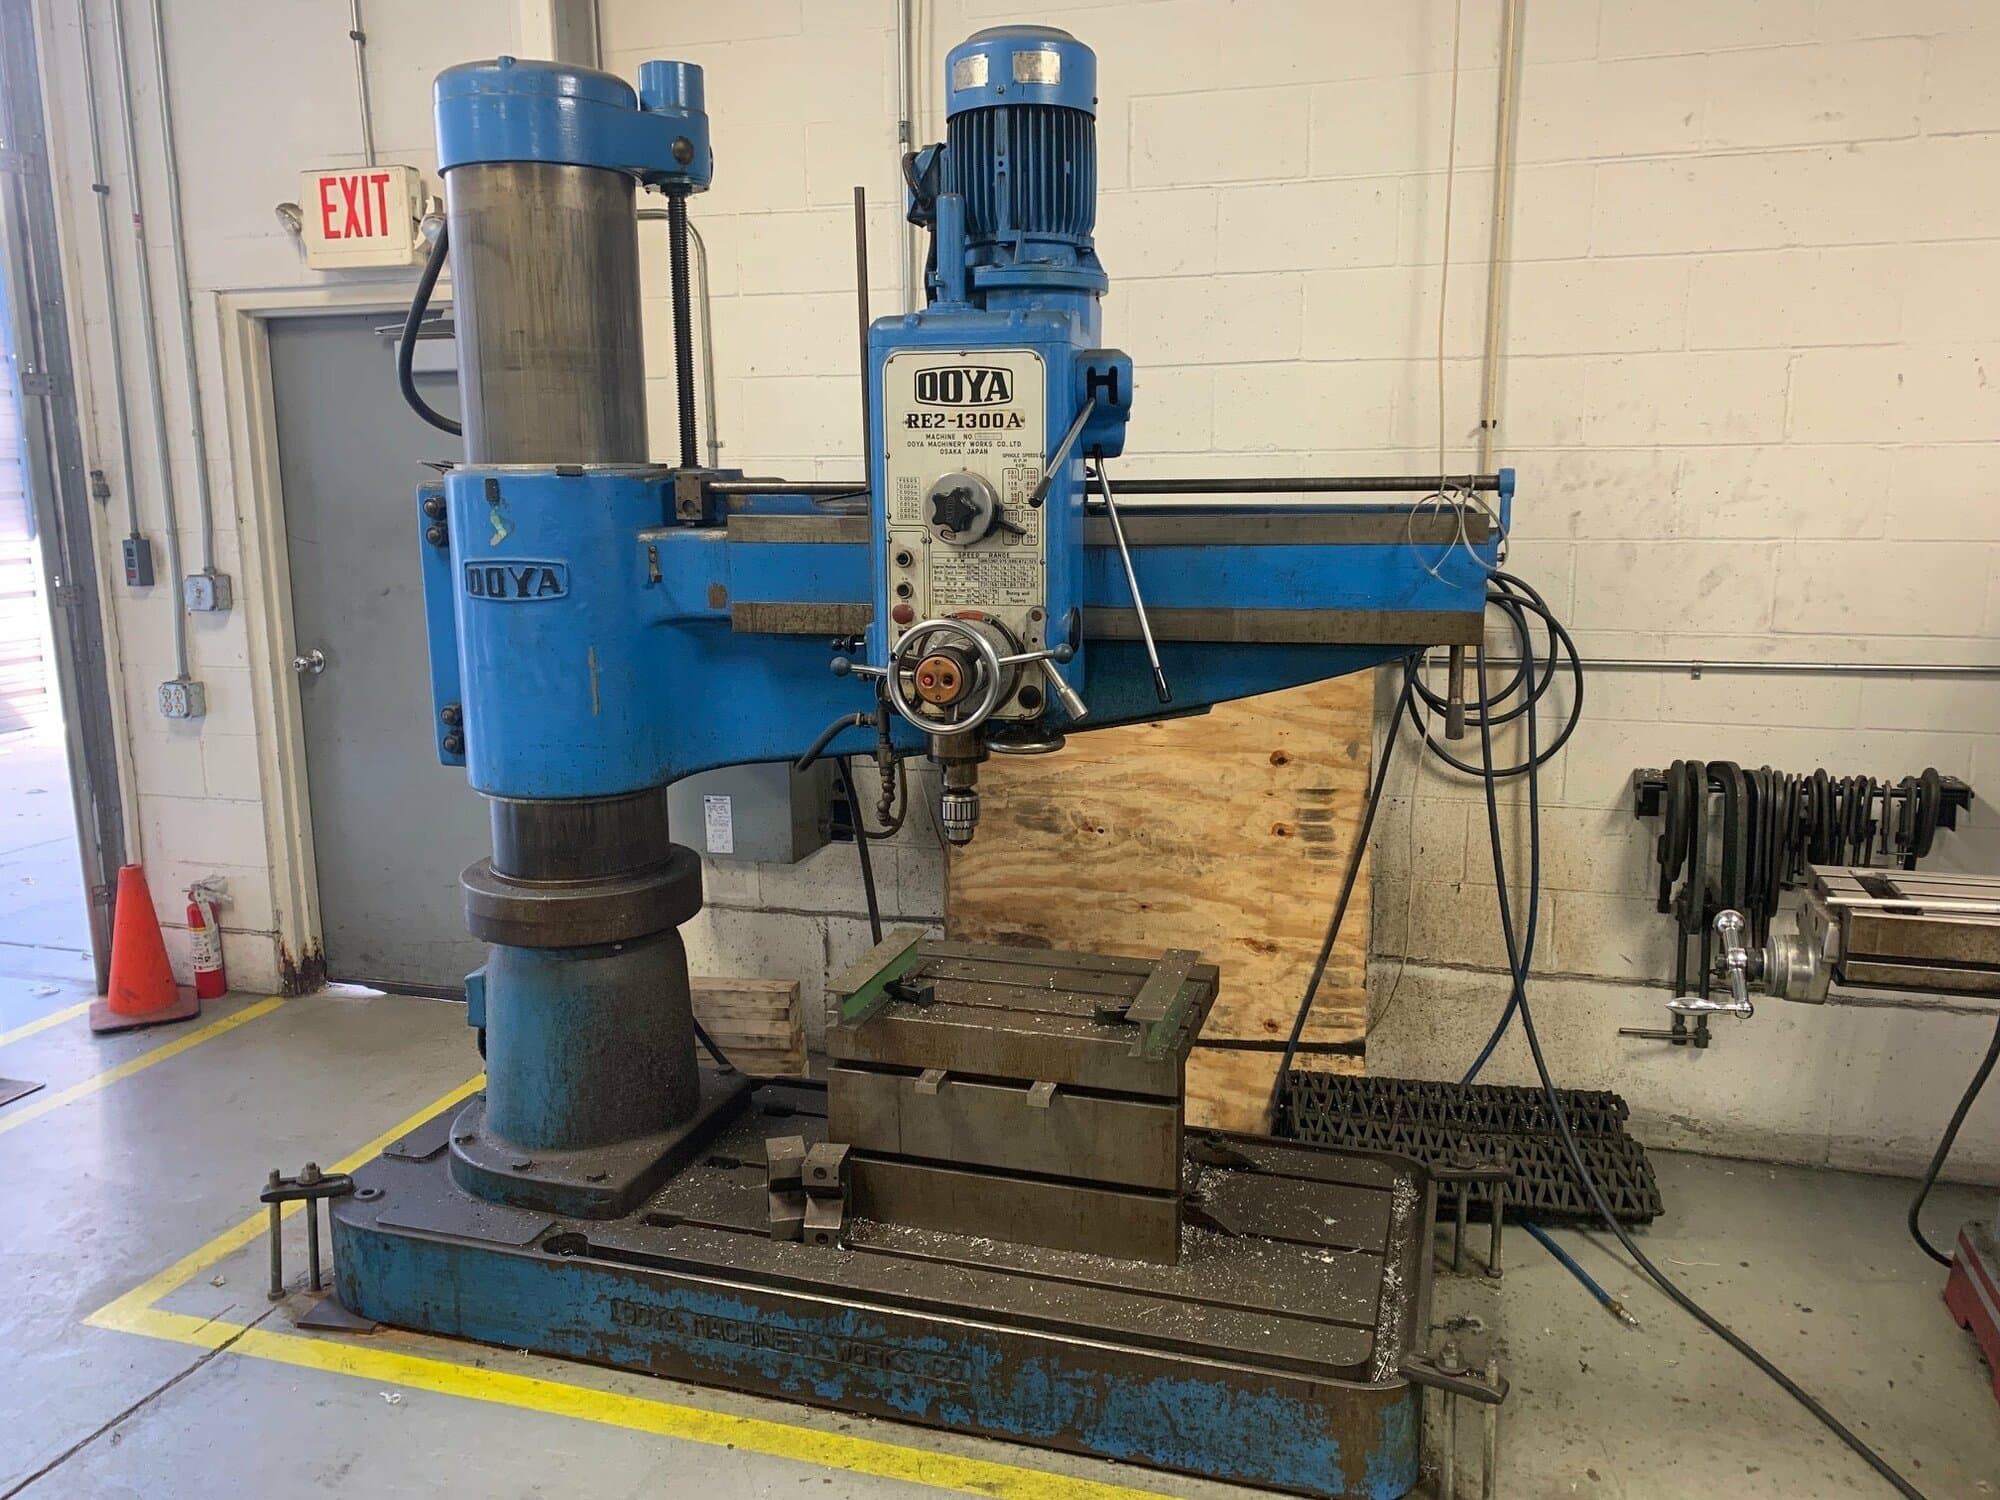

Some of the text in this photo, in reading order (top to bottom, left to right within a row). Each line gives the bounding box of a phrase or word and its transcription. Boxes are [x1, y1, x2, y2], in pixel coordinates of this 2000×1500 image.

[319, 173, 390, 239] EXIT
[918, 369, 1010, 403] OOYA
[906, 412, 1023, 429] RE2-1300A
[467, 566, 563, 598] OOYA
